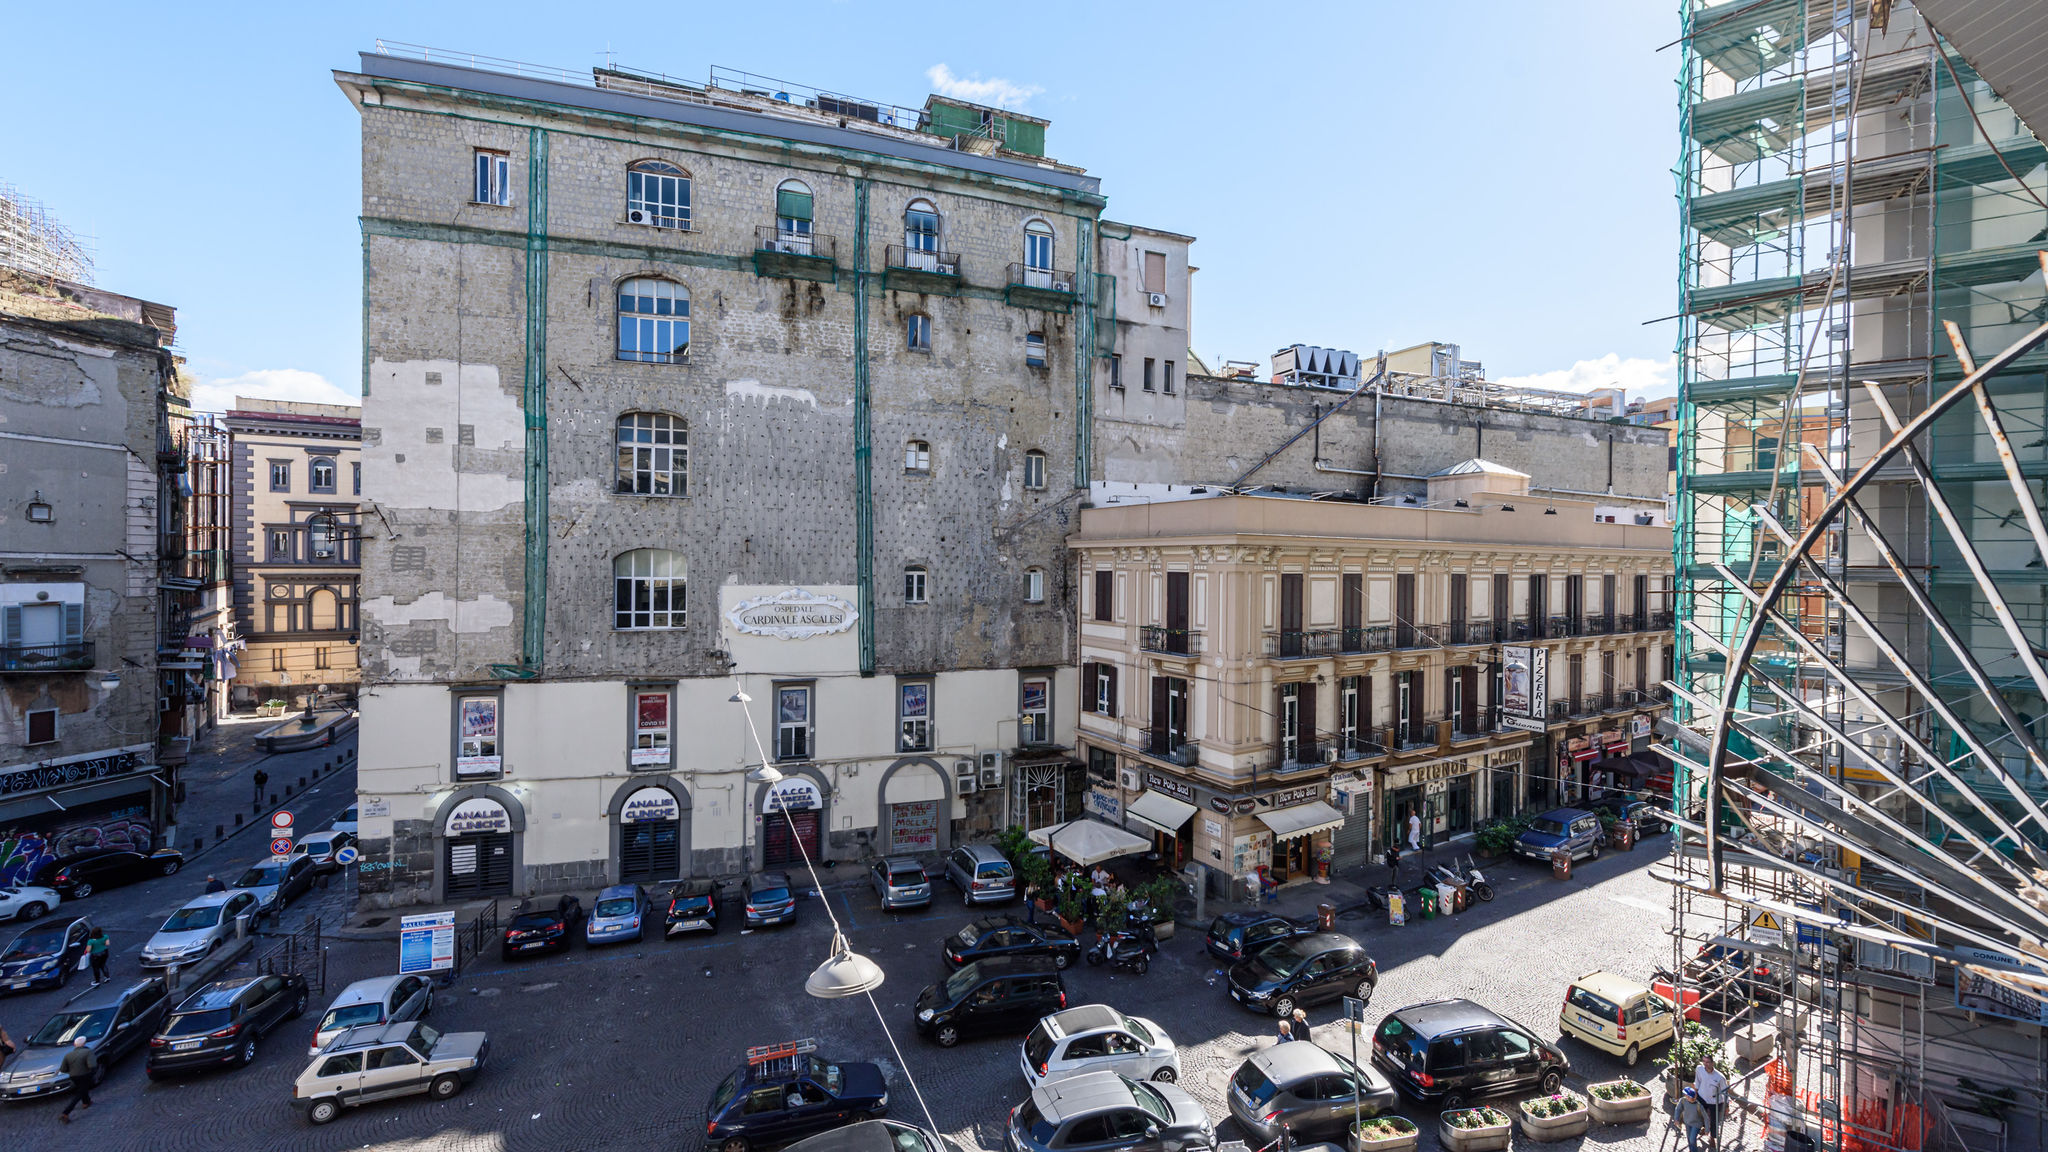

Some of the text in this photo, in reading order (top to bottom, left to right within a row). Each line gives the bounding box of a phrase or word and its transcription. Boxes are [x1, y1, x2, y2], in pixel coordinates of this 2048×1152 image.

[774, 605, 815, 613] OSPEDALE
[743, 614, 843, 625] CARDINALE ASCALESI
[1534, 649, 1545, 717] PIZZERIA
[1163, 778, 1176, 791] Polo
[1177, 784, 1189, 796] Sud
[1293, 788, 1306, 799] Polo
[1306, 785, 1317, 797] Sud
[627, 798, 673, 809] ANALISI
[453, 809, 504, 821] ANALISI
[625, 807, 675, 819] CLINICHE
[451, 819, 506, 831] CLINICHE
[1973, 951, 2013, 964] COMUNE
